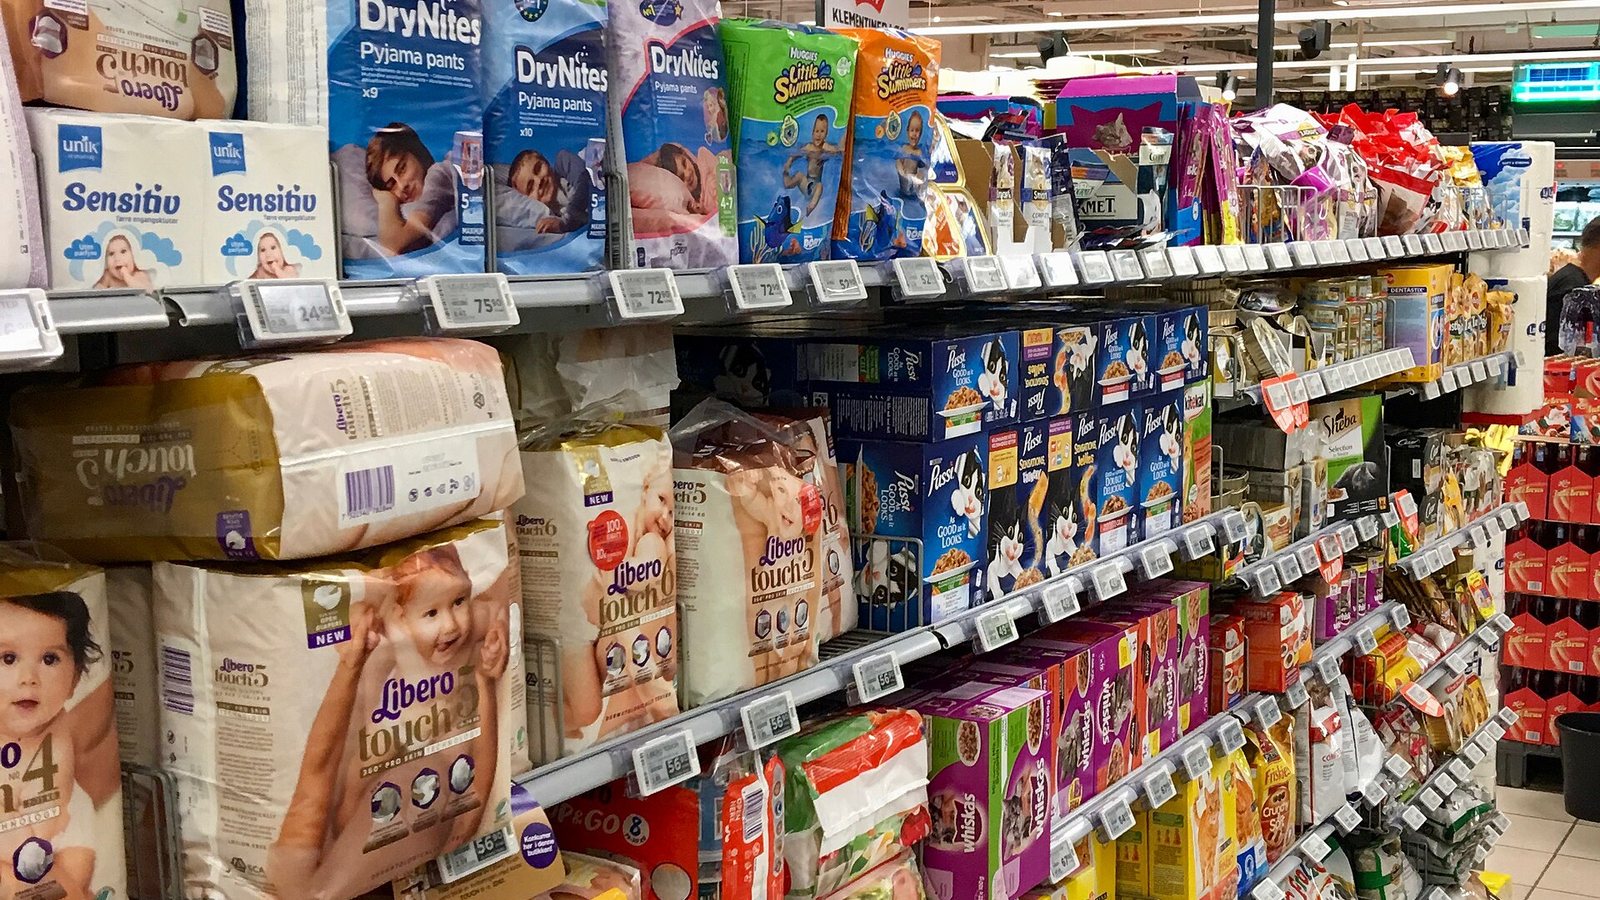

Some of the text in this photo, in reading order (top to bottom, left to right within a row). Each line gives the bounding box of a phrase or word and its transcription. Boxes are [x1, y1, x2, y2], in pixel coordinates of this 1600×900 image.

[359, 0, 480, 45] DryNites
[361, 42, 465, 71] Pyjama pants
[651, 46, 719, 79] DryNites
[96, 51, 188, 94] touch 5
[517, 50, 608, 92] DryNites
[790, 63, 819, 84] Little
[888, 62, 914, 80] Little
[121, 79, 183, 111] Libero
[362, 88, 378, 99] x9
[655, 81, 697, 94] Pyjama pants
[775, 77, 834, 104] Swimmers
[878, 74, 926, 99] Swimmers
[519, 92, 592, 112] Pyjama pants
[520, 128, 533, 137] x10
[63, 135, 98, 155] unik
[214, 143, 241, 159] unik
[63, 182, 181, 215] Sensitiv
[217, 184, 317, 213] Sensitiv
[461, 193, 469, 209] 5
[591, 193, 598, 207] 5
[720, 196, 733, 209] 4-7
[947, 349, 966, 373] Pussi
[956, 377, 972, 386] LOOKS
[332, 394, 346, 431] Libero
[1078, 417, 1095, 440] Pussi
[1099, 424, 1117, 448] Pussi
[1143, 413, 1161, 439] Pussi
[1323, 414, 1357, 438] Sheba
[1023, 432, 1042, 456] Pussi
[104, 444, 196, 481] touch
[895, 471, 912, 512] Pussi
[928, 464, 955, 497] Pussi
[589, 495, 608, 504] NEW
[693, 483, 707, 504] 5
[888, 484, 896, 512] GOOD
[544, 521, 557, 536] 6
[937, 526, 957, 538] GOOD
[760, 535, 803, 566] Libero
[942, 535, 962, 549] LOOKS
[751, 535, 814, 593] touch 5
[608, 558, 662, 596] Libero
[599, 584, 658, 625] touch
[661, 558, 674, 597] 6
[316, 631, 345, 645] NEW
[122, 652, 134, 674] 5
[220, 658, 254, 673] Libero
[215, 664, 269, 687] touch 5
[371, 671, 454, 724] Libero
[359, 665, 479, 762] touch 5
[1102, 677, 1111, 745] whiskas
[1082, 700, 1091, 772] whiskas
[22, 733, 59, 794] 4
[384, 758, 402, 769] PRO
[404, 751, 423, 763] SKIN
[1036, 758, 1044, 840] whiskas
[629, 816, 642, 835] 8
[964, 793, 976, 853] whiskas
